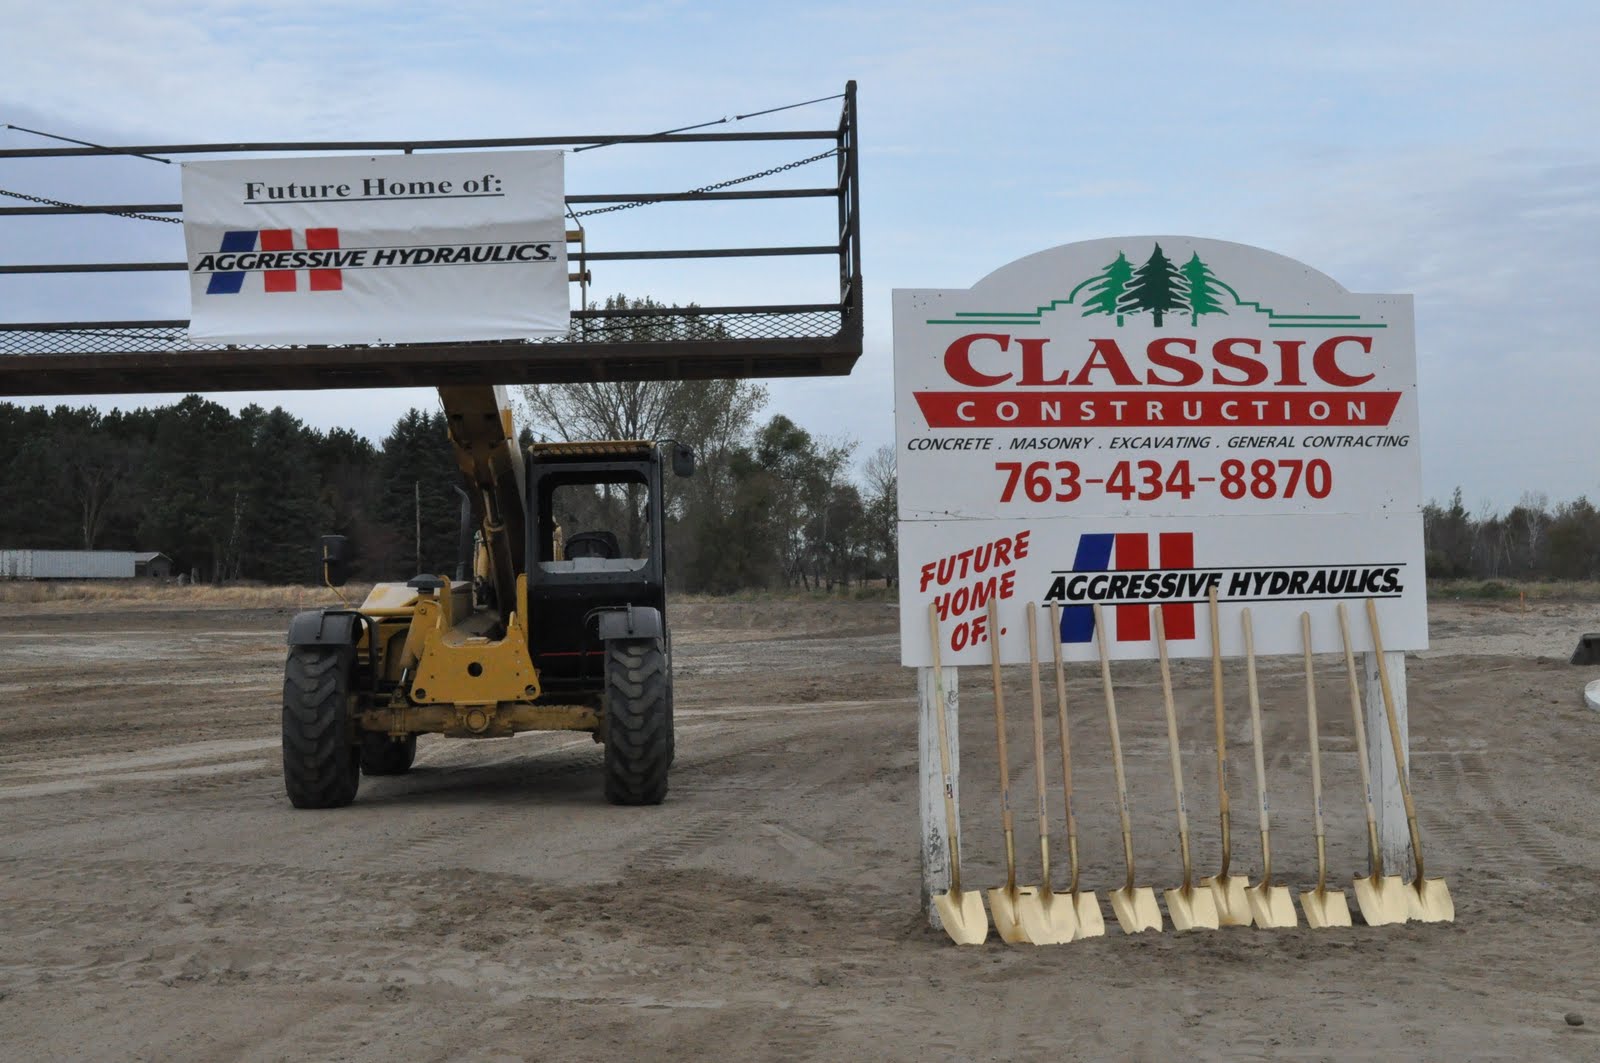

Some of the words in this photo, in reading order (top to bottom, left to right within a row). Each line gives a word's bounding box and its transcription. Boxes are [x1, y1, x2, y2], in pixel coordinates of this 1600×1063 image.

[245, 181, 351, 200] Future
[360, 177, 453, 197] Home
[462, 174, 503, 194] of:
[194, 249, 367, 272] AGGRESSIVE
[943, 333, 1376, 388] CLASSIC
[956, 400, 1367, 422] CONSTRUCTION
[906, 437, 993, 451] CONCRETE
[1008, 436, 1094, 450] MASONRY
[1109, 435, 1211, 450] EXCAVATING
[1227, 435, 1296, 449] GENERAL
[1302, 434, 1409, 449] CONTRACTING
[995, 458, 1333, 502] 763-434-8870
[920, 530, 1030, 592] FUTURE
[934, 570, 1016, 621] HOME
[1044, 571, 1223, 602] AGGRESSIVE
